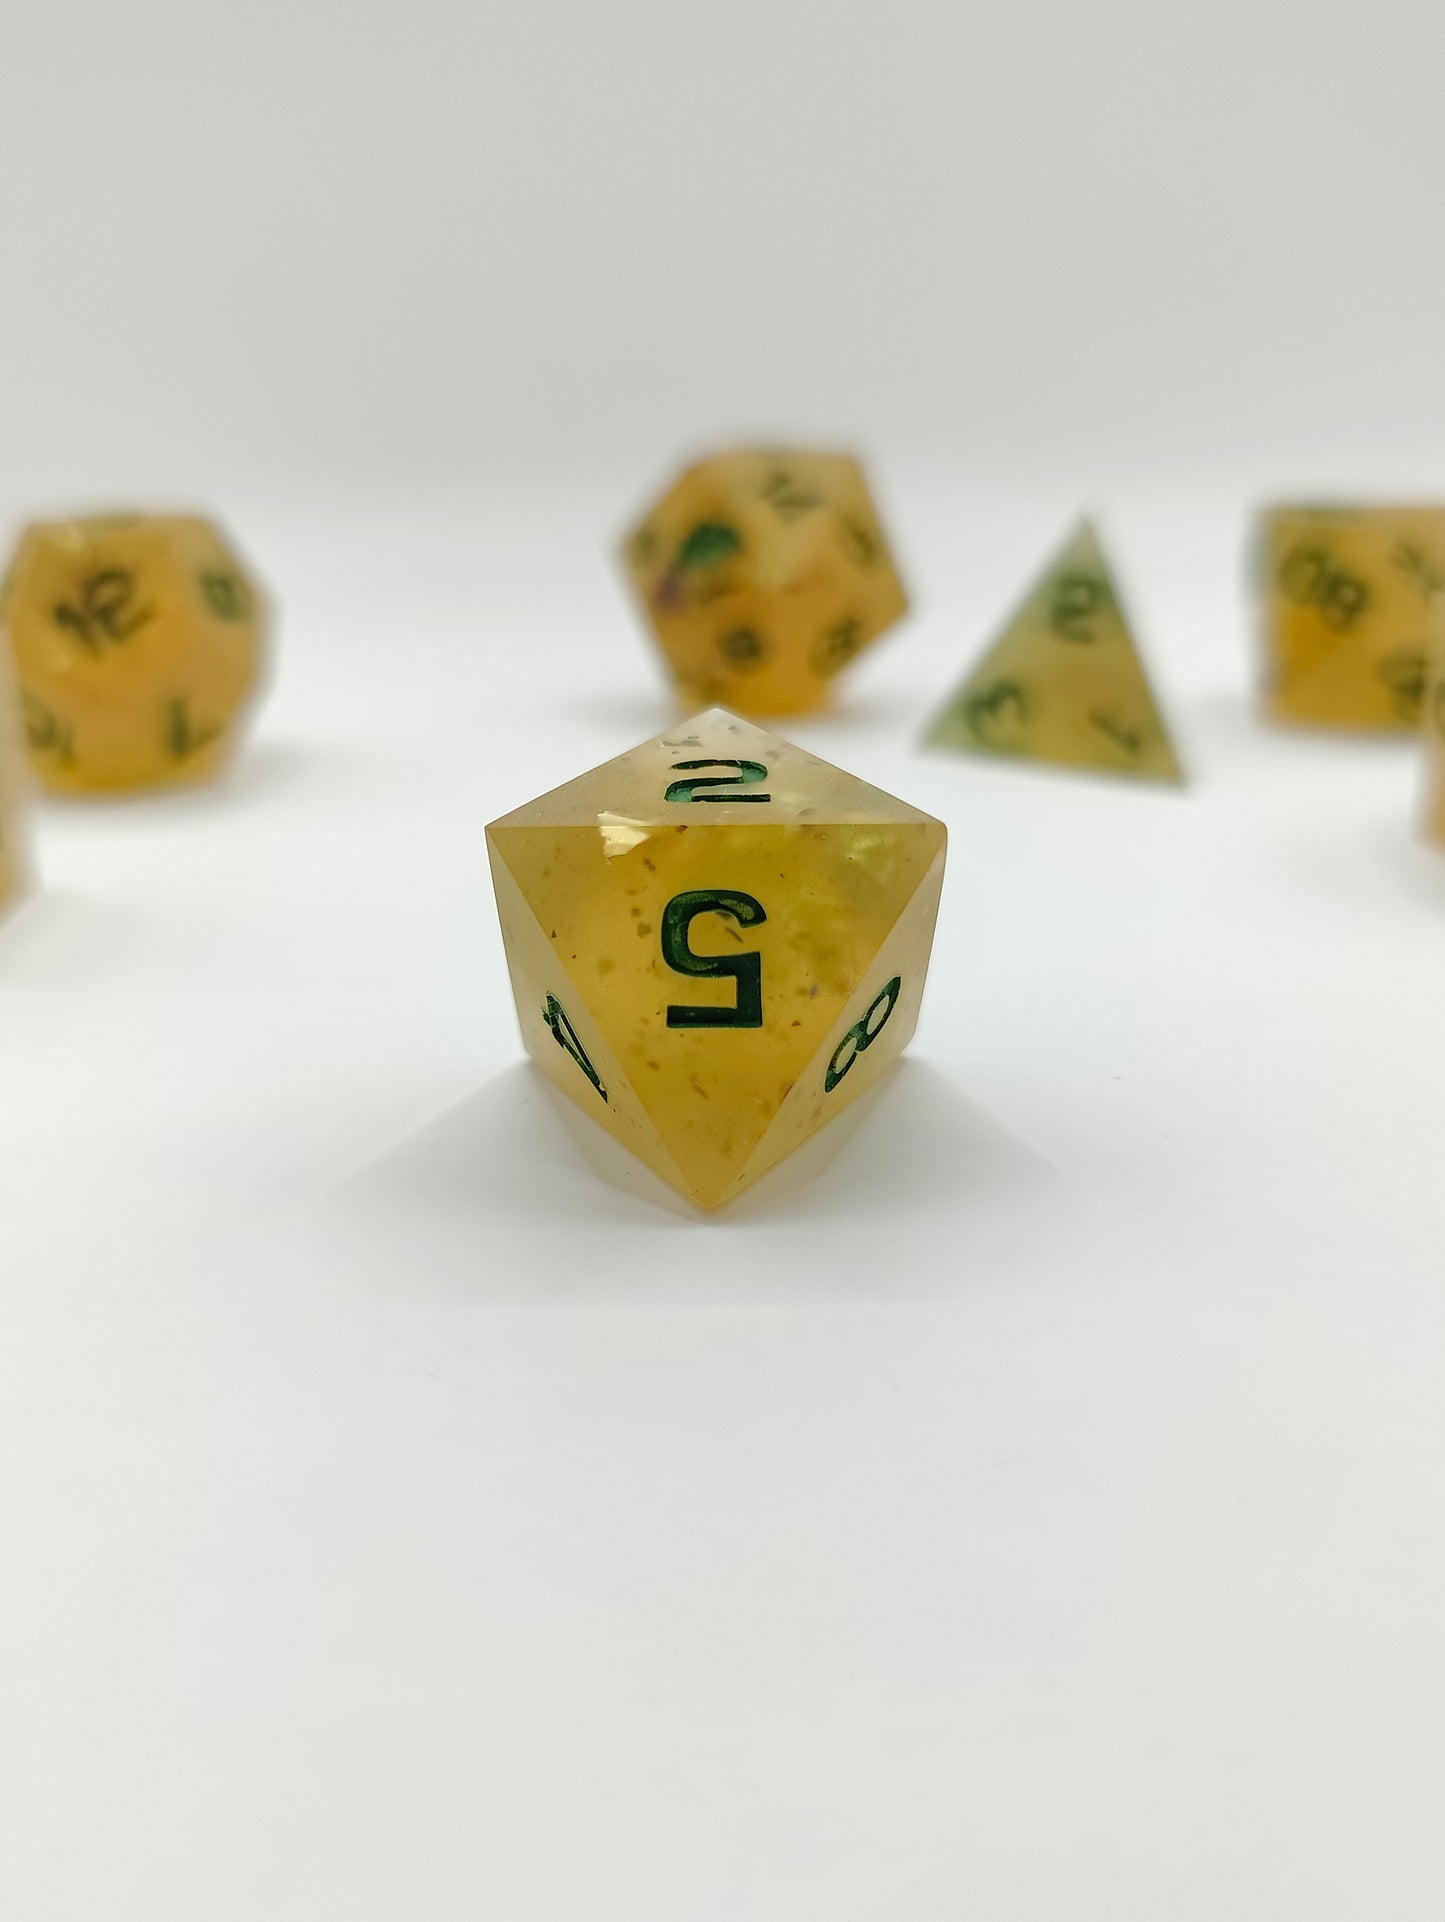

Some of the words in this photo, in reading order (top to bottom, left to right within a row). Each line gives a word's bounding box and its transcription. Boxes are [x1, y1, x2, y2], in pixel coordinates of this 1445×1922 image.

[664, 758, 772, 803] 2
[661, 889, 768, 1029] 5
[824, 975, 901, 1093] 8
